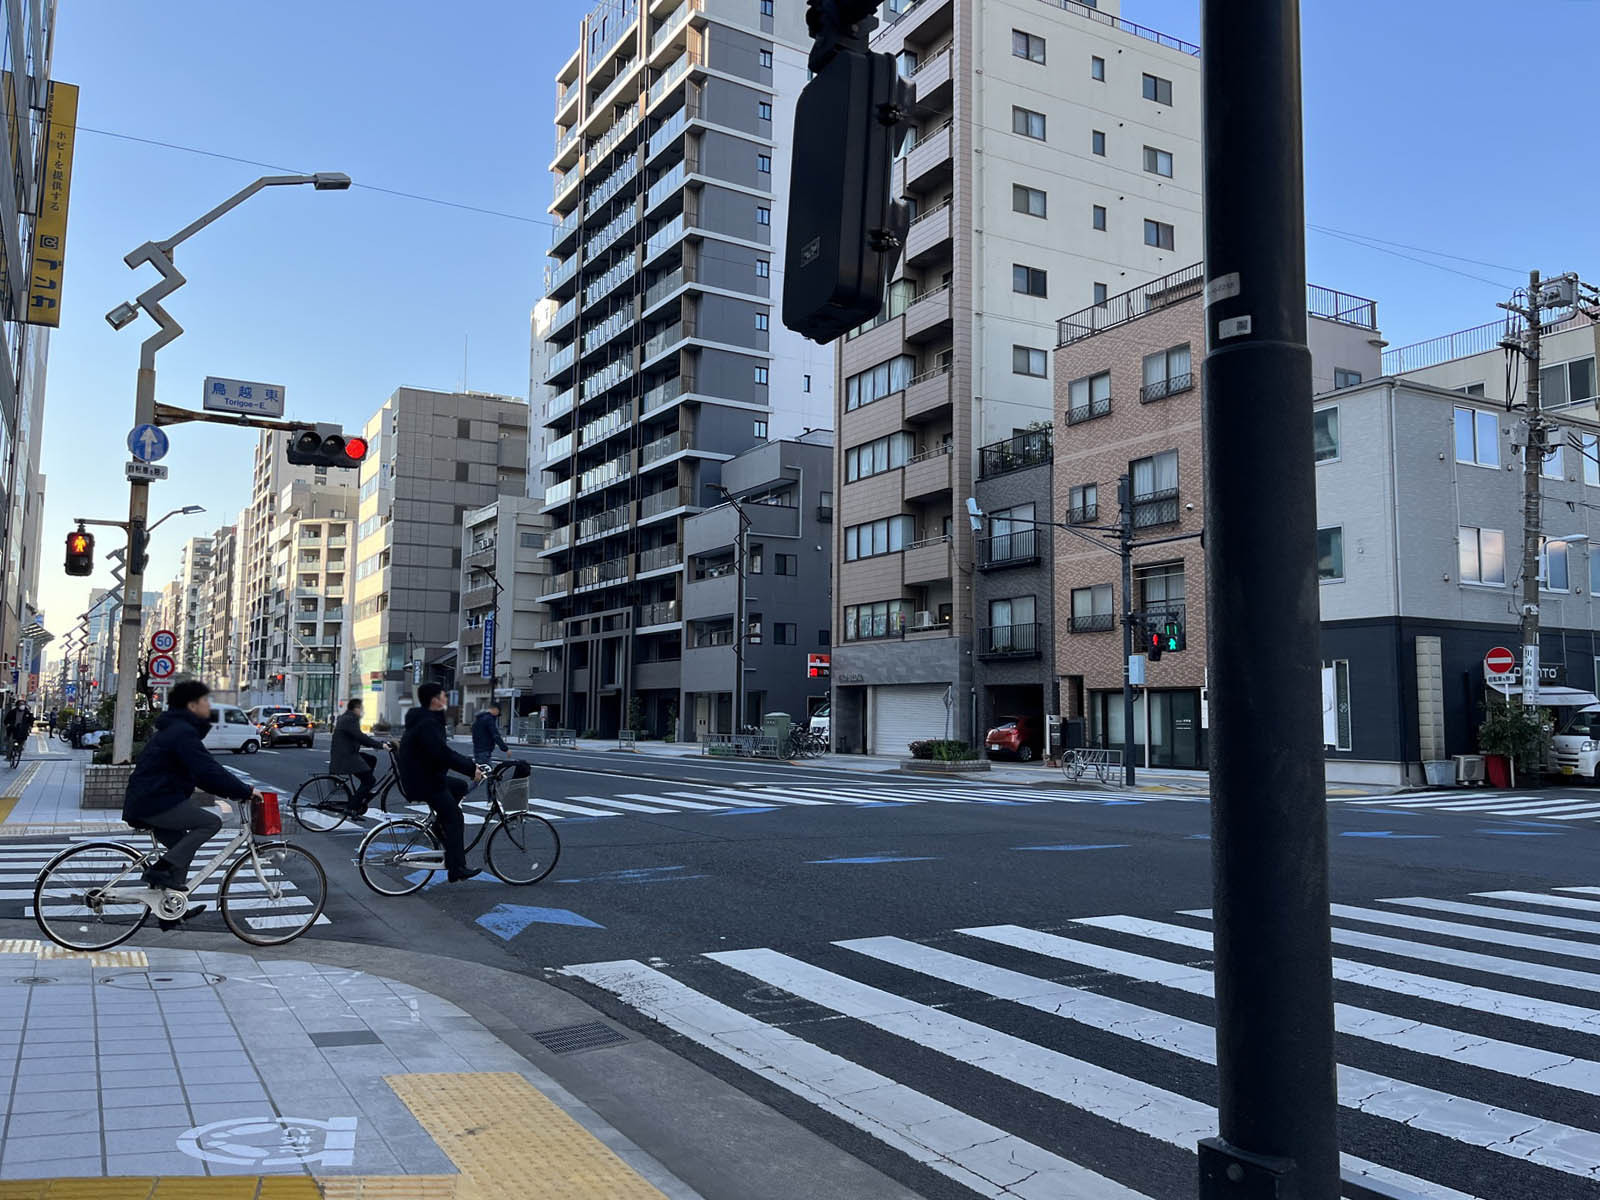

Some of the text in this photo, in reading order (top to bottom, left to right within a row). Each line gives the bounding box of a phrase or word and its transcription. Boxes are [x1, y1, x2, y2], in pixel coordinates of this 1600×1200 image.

[49, 130, 66, 212] ホビーを提供する
[212, 382, 279, 402] 鳥越東
[157, 636, 172, 647] 50
